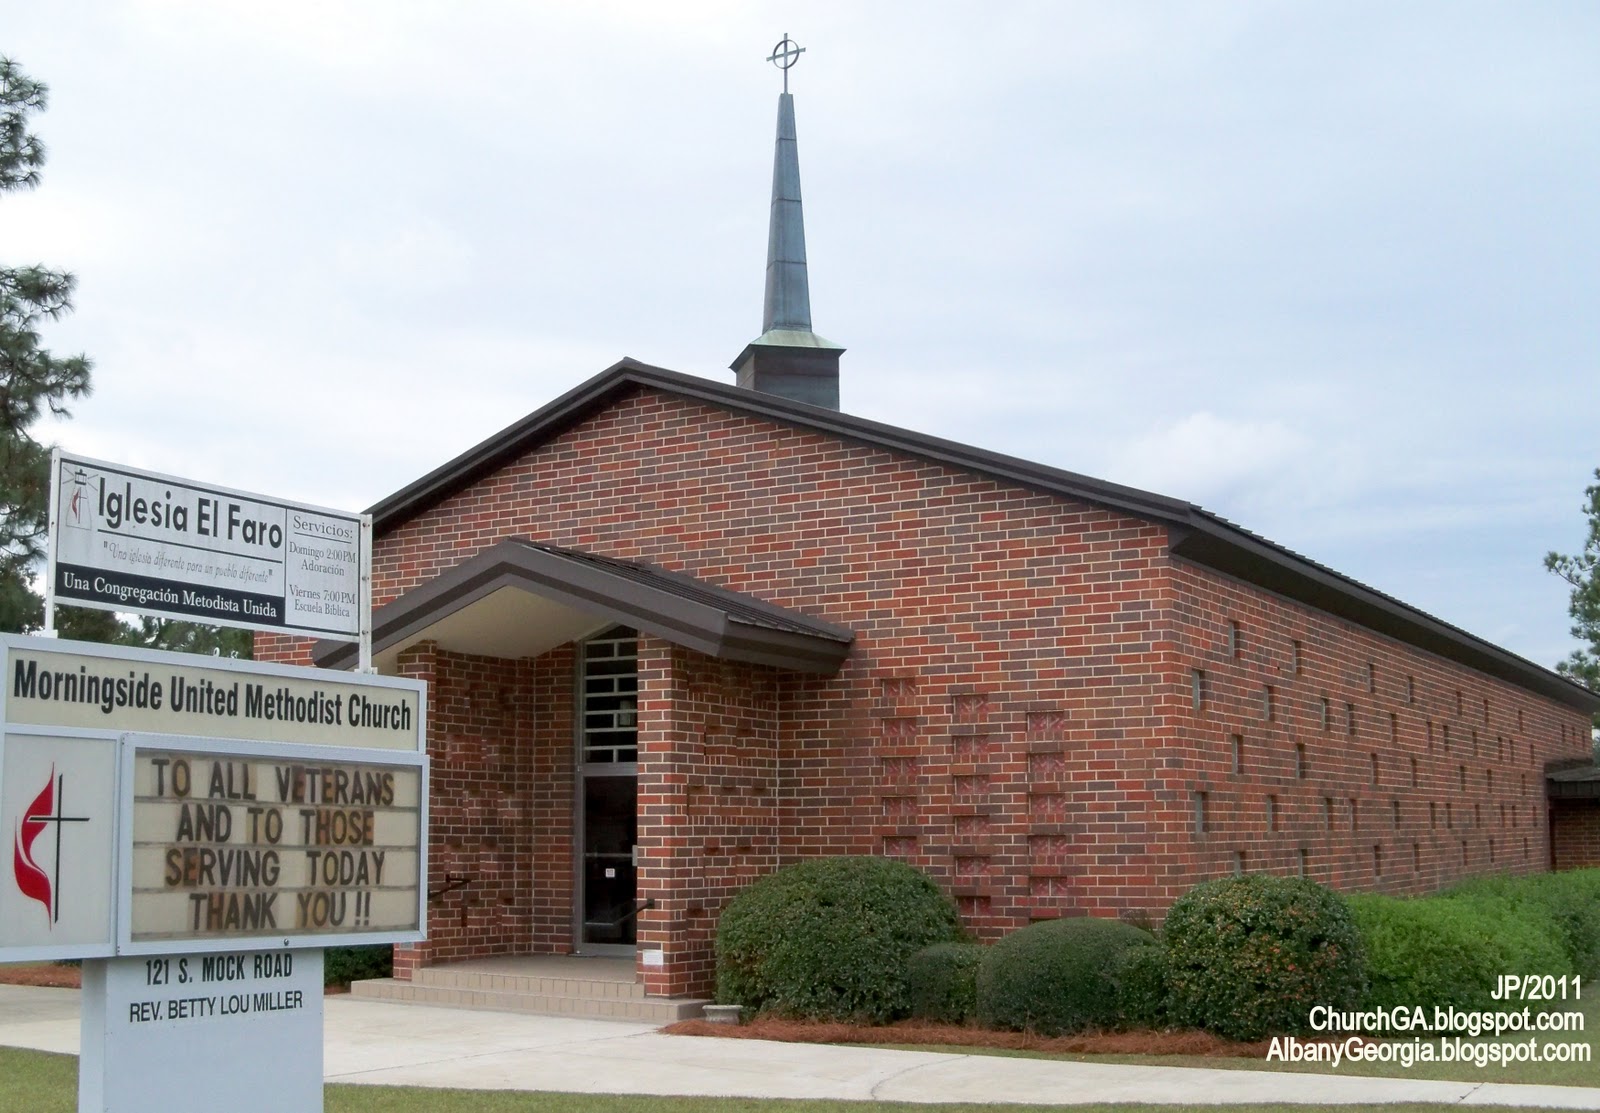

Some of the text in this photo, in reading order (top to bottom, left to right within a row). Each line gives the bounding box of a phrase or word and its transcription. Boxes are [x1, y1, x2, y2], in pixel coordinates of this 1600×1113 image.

[98, 477, 283, 549] Iglesia El Faro
[293, 515, 353, 539] Servicios:
[154, 551, 185, 571] diferente
[289, 541, 325, 560] Domingo
[301, 559, 345, 576] Adoración
[64, 571, 277, 618] Una Congregación Metodista Unida
[289, 584, 321, 600] Viernes
[294, 598, 322, 614] Escuela
[14, 659, 412, 732] Morningside United Methodist Church
[151, 758, 395, 806] TO ALL VETERANS
[176, 804, 374, 846] AND TO THOSE
[165, 848, 386, 887] SERVING TODAY
[190, 892, 278, 930] THANK
[145, 953, 293, 986] 121 S. MOCK ROAD
[129, 989, 303, 1023] REV. BETTY LOU MILLER
